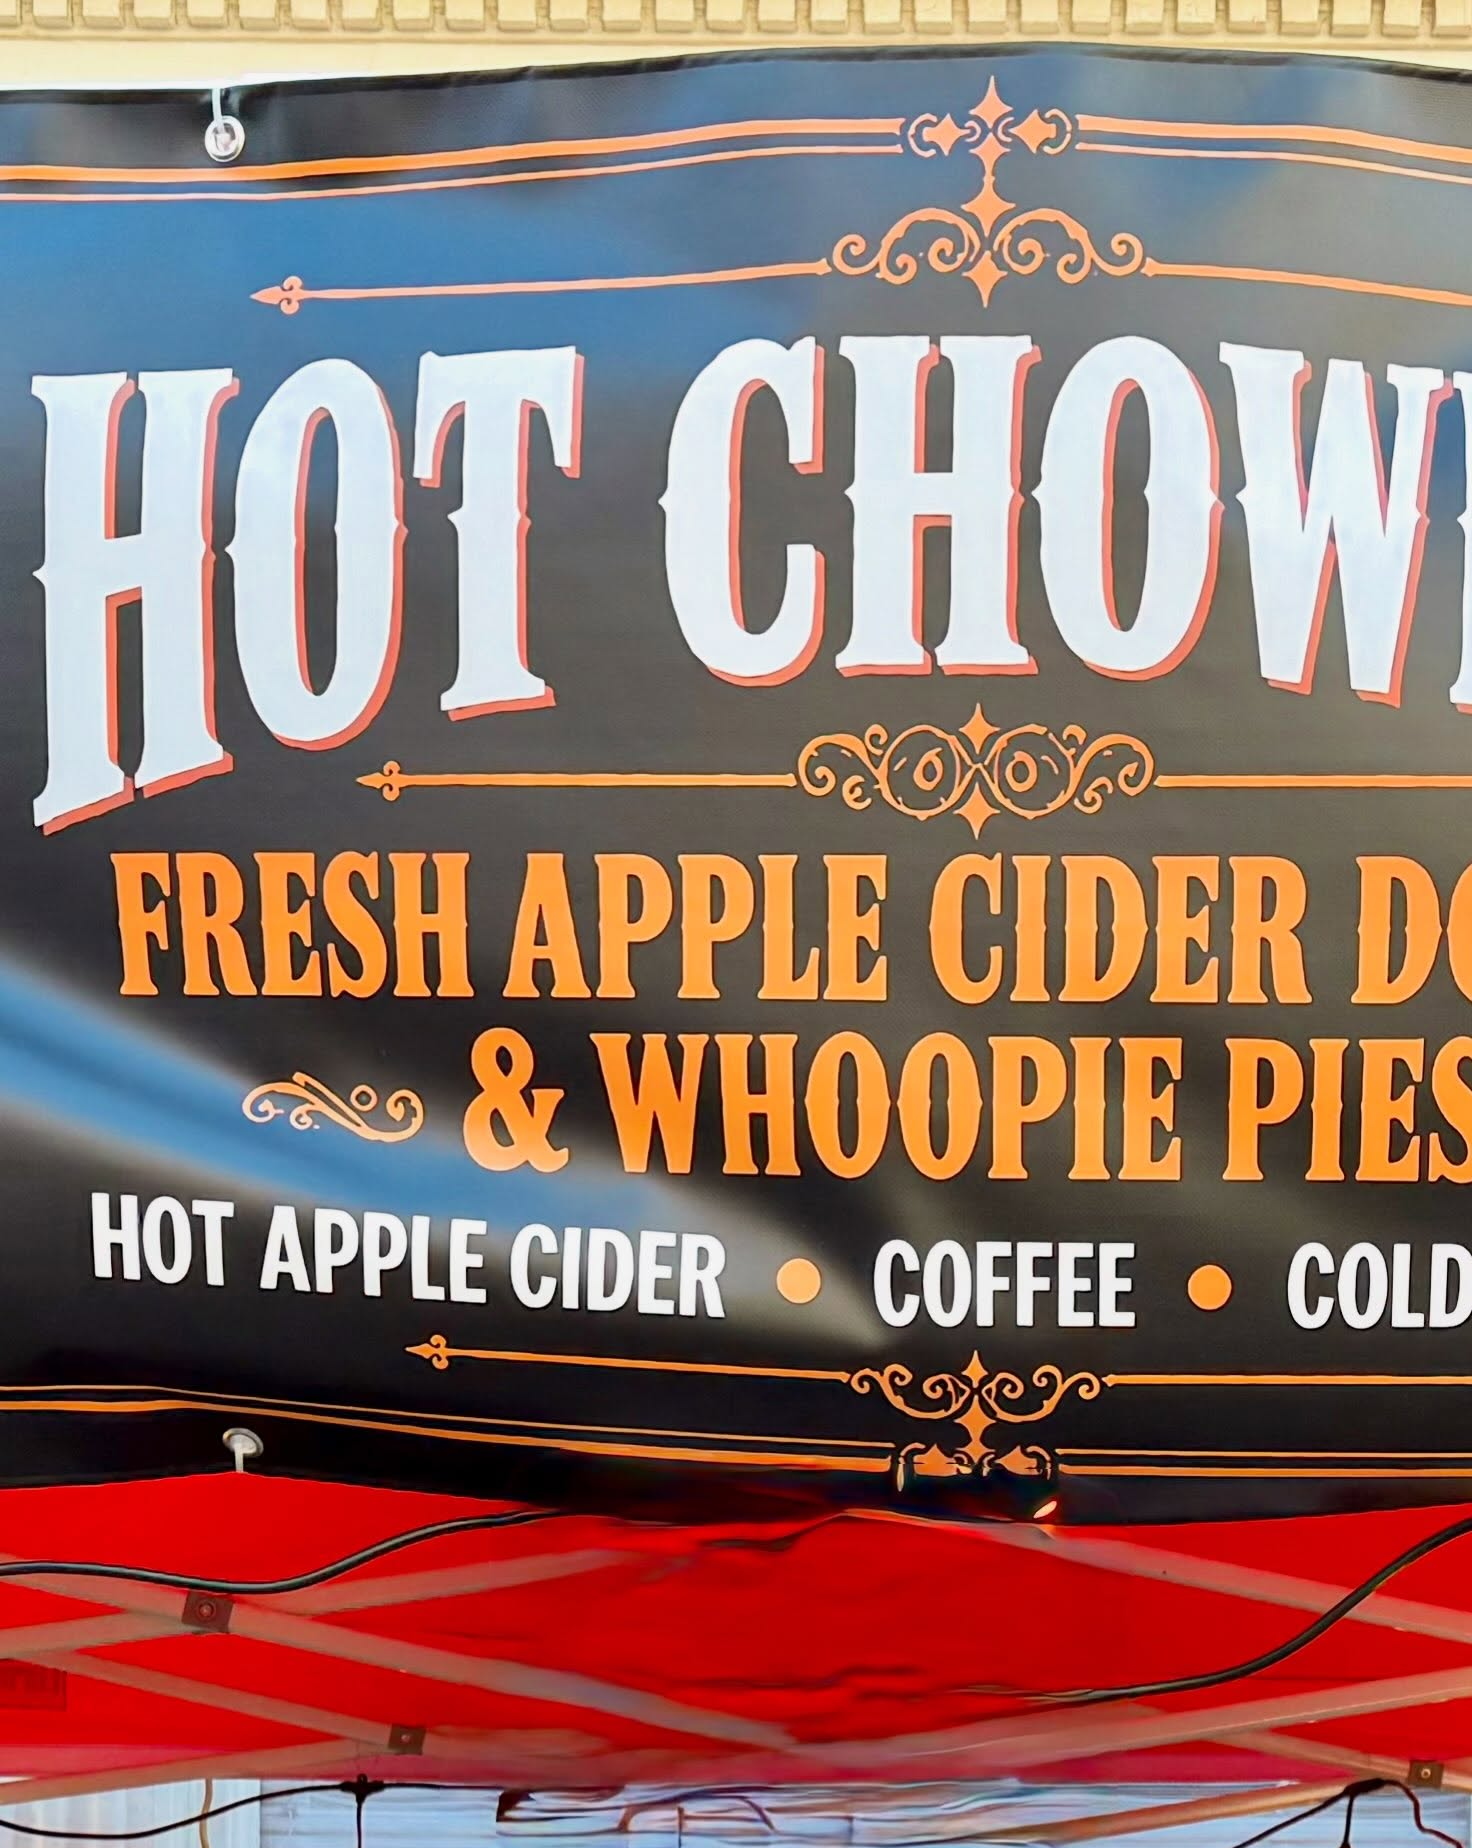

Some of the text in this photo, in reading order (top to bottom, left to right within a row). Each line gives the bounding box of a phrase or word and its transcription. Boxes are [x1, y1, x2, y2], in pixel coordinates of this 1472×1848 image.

[31, 344, 584, 835] HOT
[110, 851, 475, 998] FRESH
[501, 852, 889, 1002] APPLE
[927, 852, 1314, 1005] CIDER
[462, 1027, 570, 1174] &
[590, 1031, 1185, 1183] WHOOPIE
[90, 1190, 237, 1286] HOT
[258, 1204, 488, 1306] APPLE
[509, 1222, 727, 1319] CIDER
[873, 1238, 1137, 1331] COFFEE
